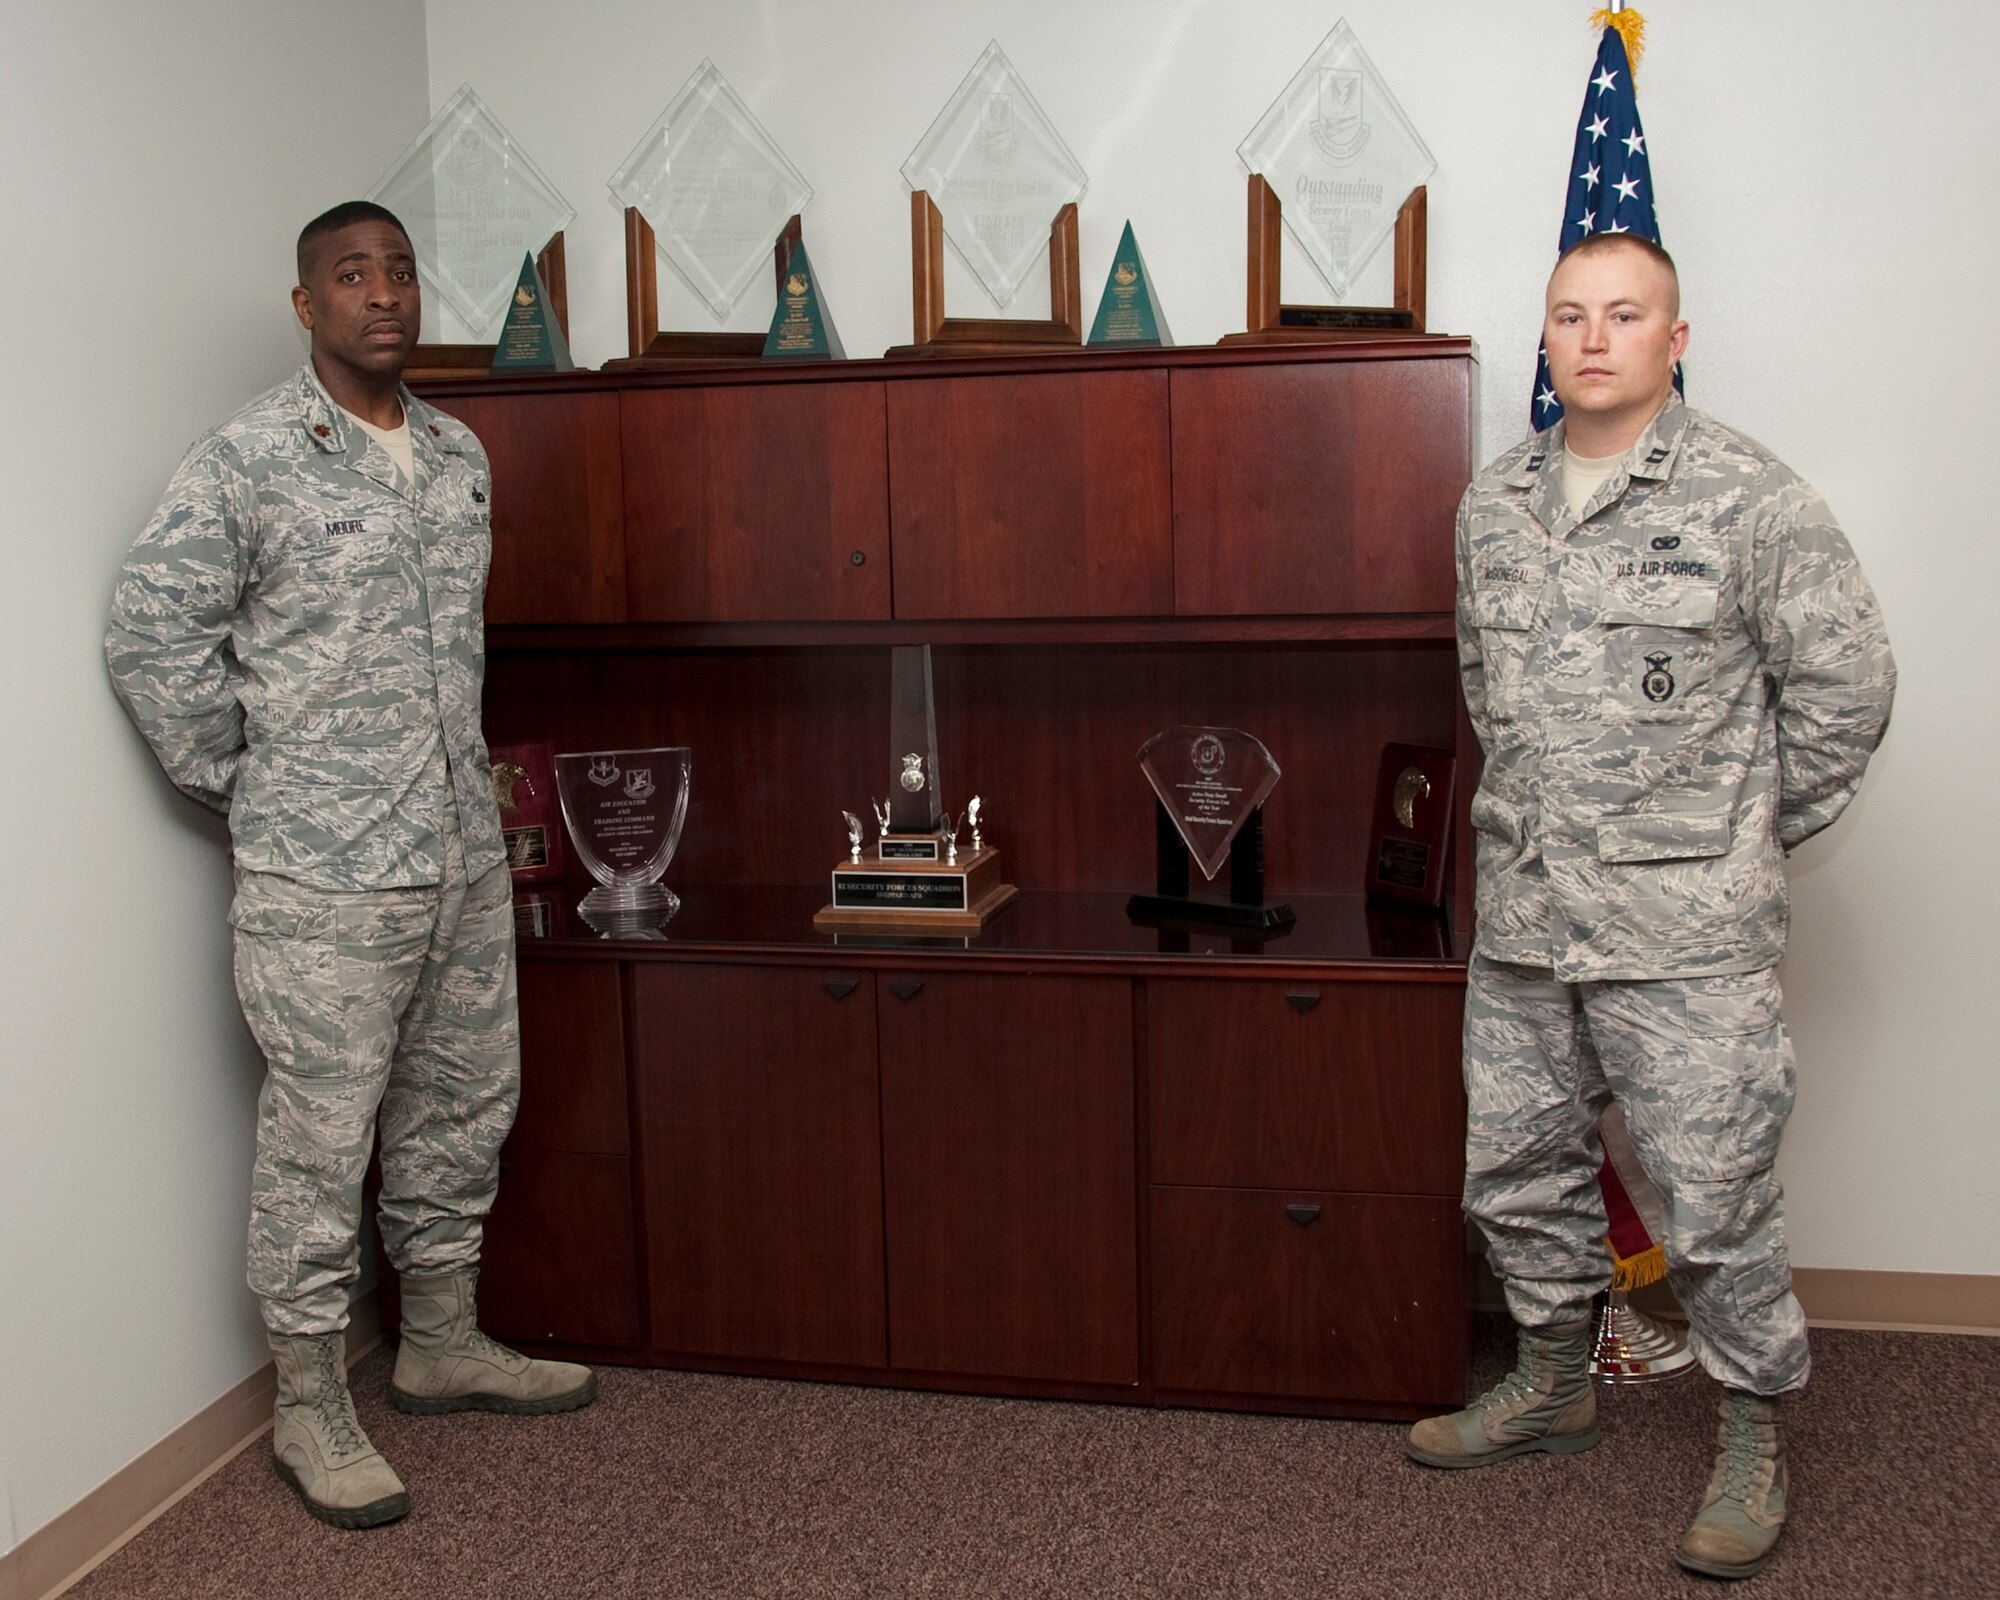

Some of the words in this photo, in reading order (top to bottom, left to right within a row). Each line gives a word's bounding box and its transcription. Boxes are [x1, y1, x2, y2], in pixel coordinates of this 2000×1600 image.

[1296, 174, 1384, 201] Outstanding
[325, 519, 368, 537] MOORE
[1617, 562, 1635, 577] U.S.
[1639, 561, 1660, 575] AIR
[1663, 561, 1706, 577] FORCE
[837, 882, 846, 890] 82
[847, 883, 885, 891] SECURITY
[886, 884, 917, 892] FORCES
[918, 884, 961, 893] SQUADRON
